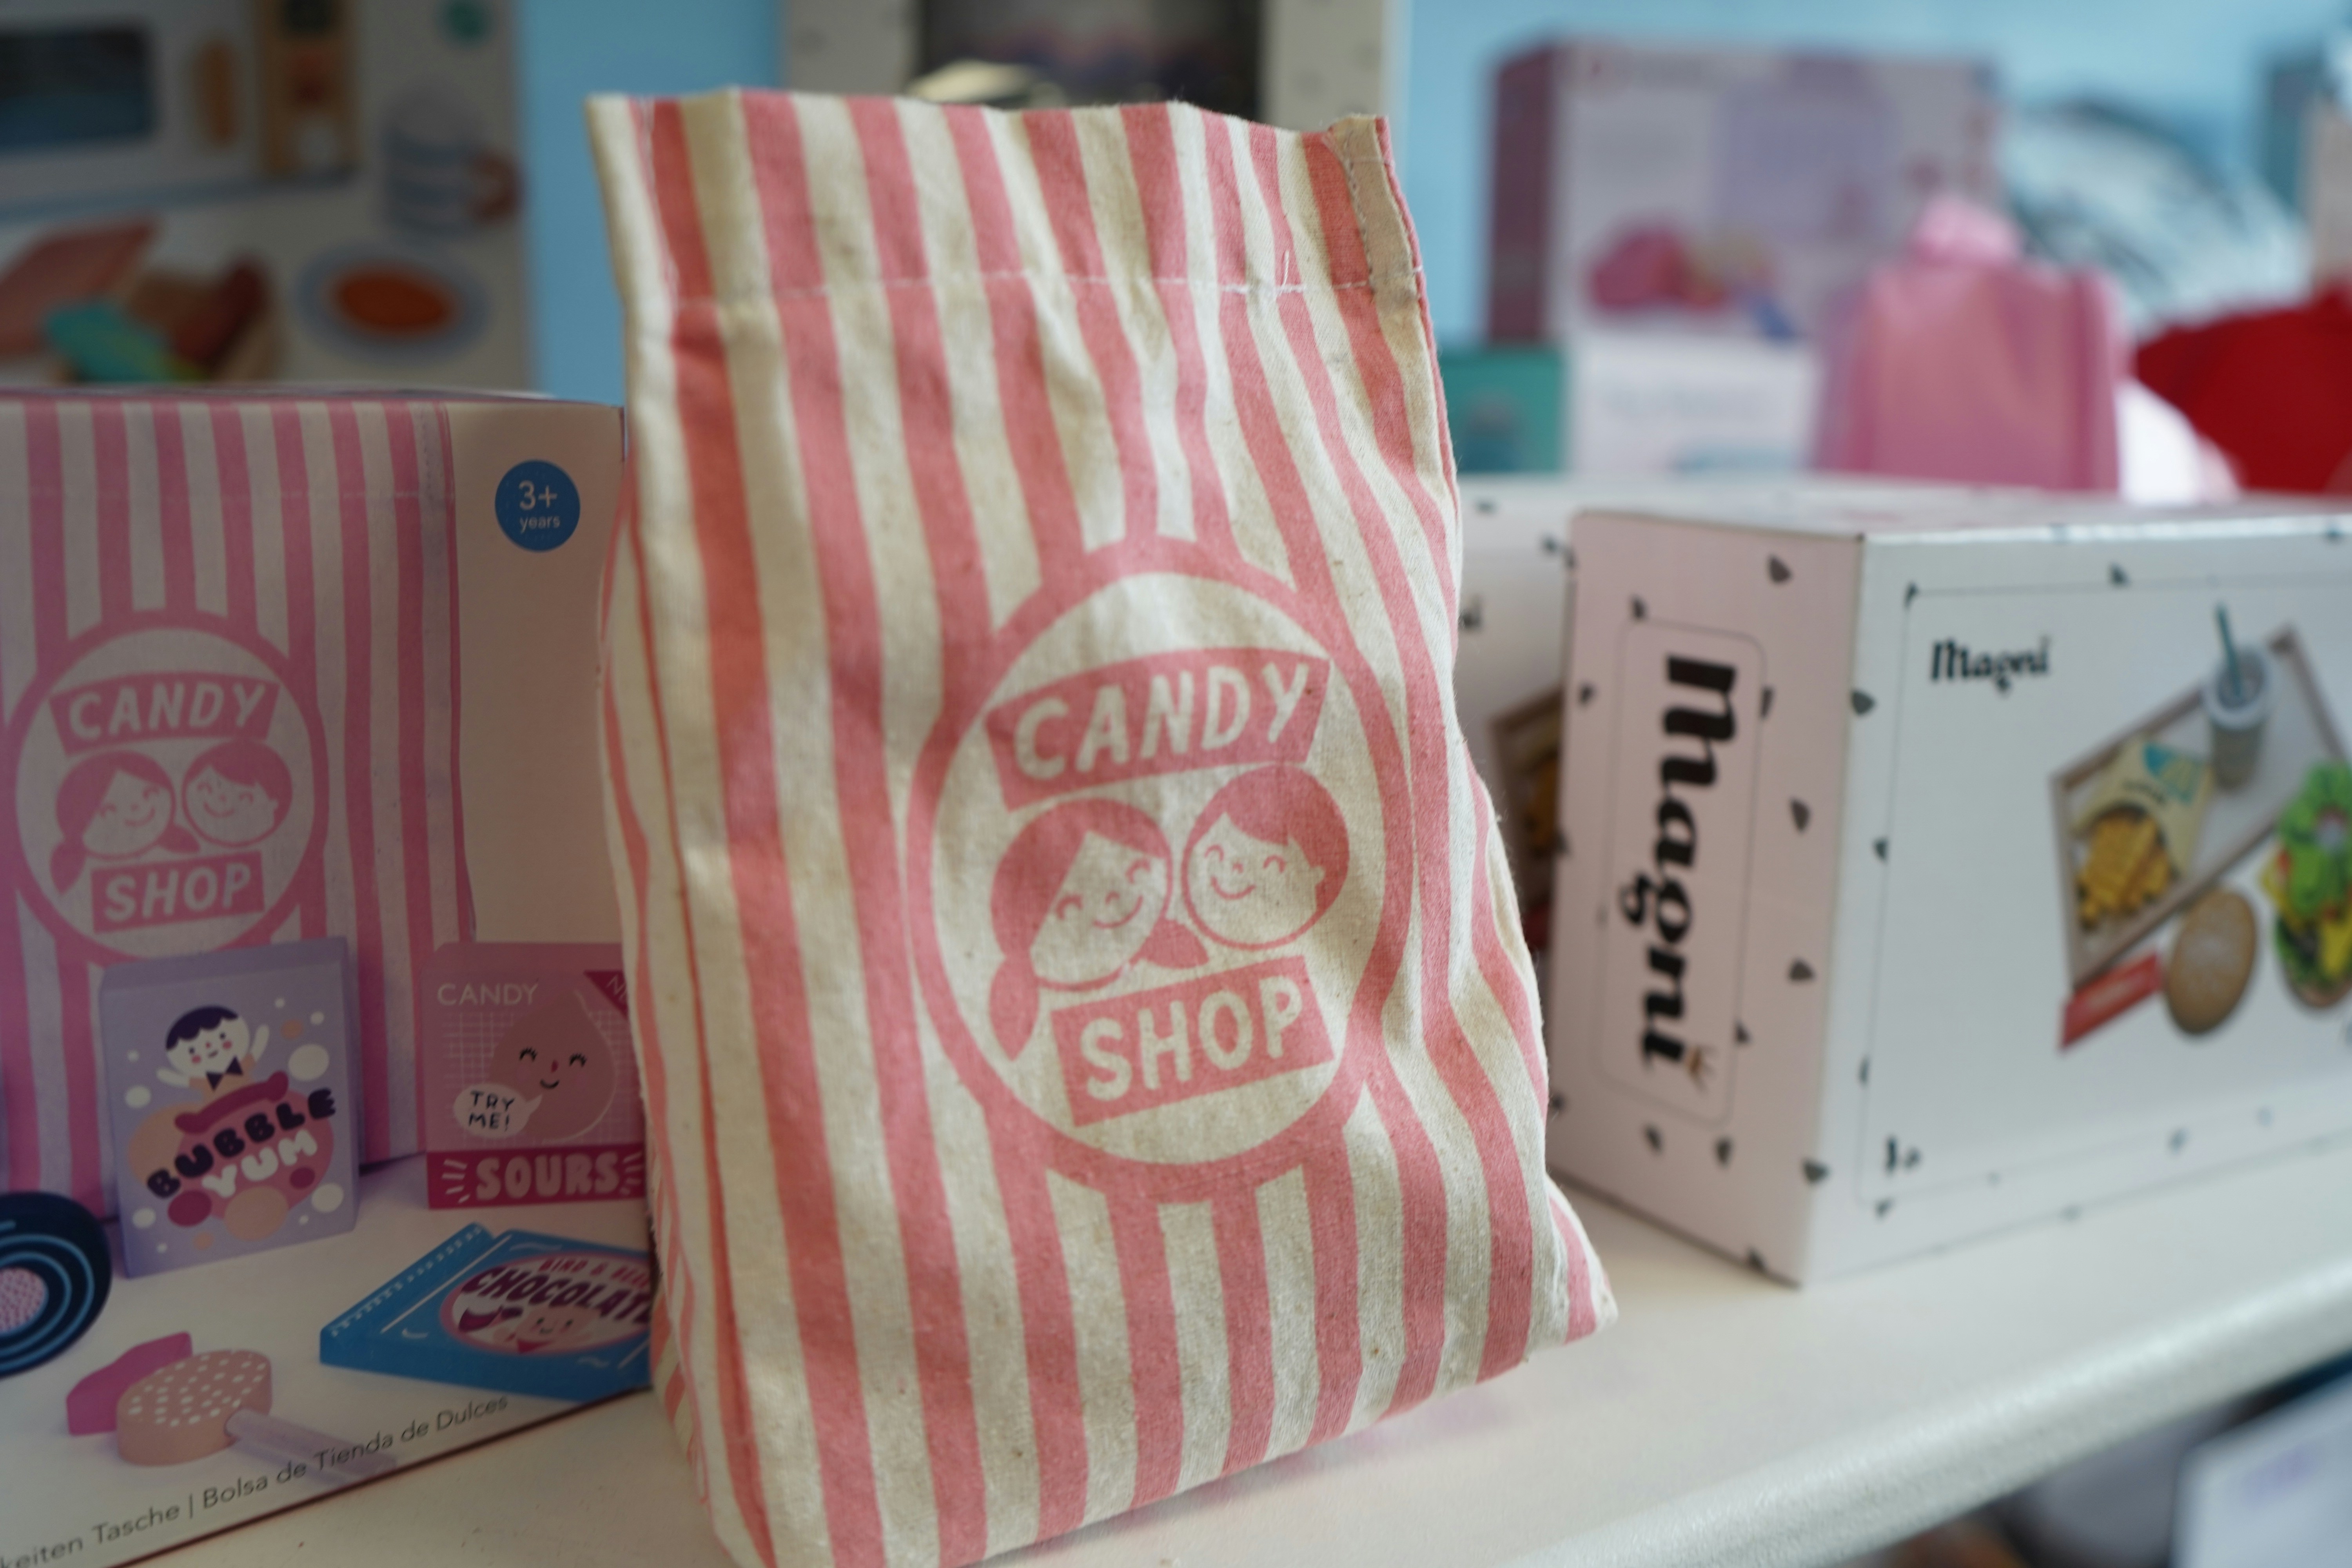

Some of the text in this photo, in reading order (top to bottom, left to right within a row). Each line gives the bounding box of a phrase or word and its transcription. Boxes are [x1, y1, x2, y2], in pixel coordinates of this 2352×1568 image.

[518, 479, 558, 510] 3+
[519, 515, 561, 534] years
[68, 681, 267, 739] CANDY
[1013, 662, 1310, 779] CANDY
[103, 862, 252, 922] SHOP
[437, 982, 539, 1006] CANDY
[1079, 975, 1302, 1100] SHOP
[468, 1112, 510, 1131] ME!
[470, 1091, 515, 1112] TRY
[147, 1087, 336, 1199] BUBBLE
[201, 1128, 318, 1198] YUM
[475, 1151, 620, 1201] SOURS
[92, 1505, 180, 1544] Tasche
[203, 1475, 268, 1509] Bolsa
[276, 1460, 307, 1485] de
[313, 1430, 394, 1472] Tienda
[400, 1419, 429, 1442] de
[436, 1395, 509, 1432] Dulces
